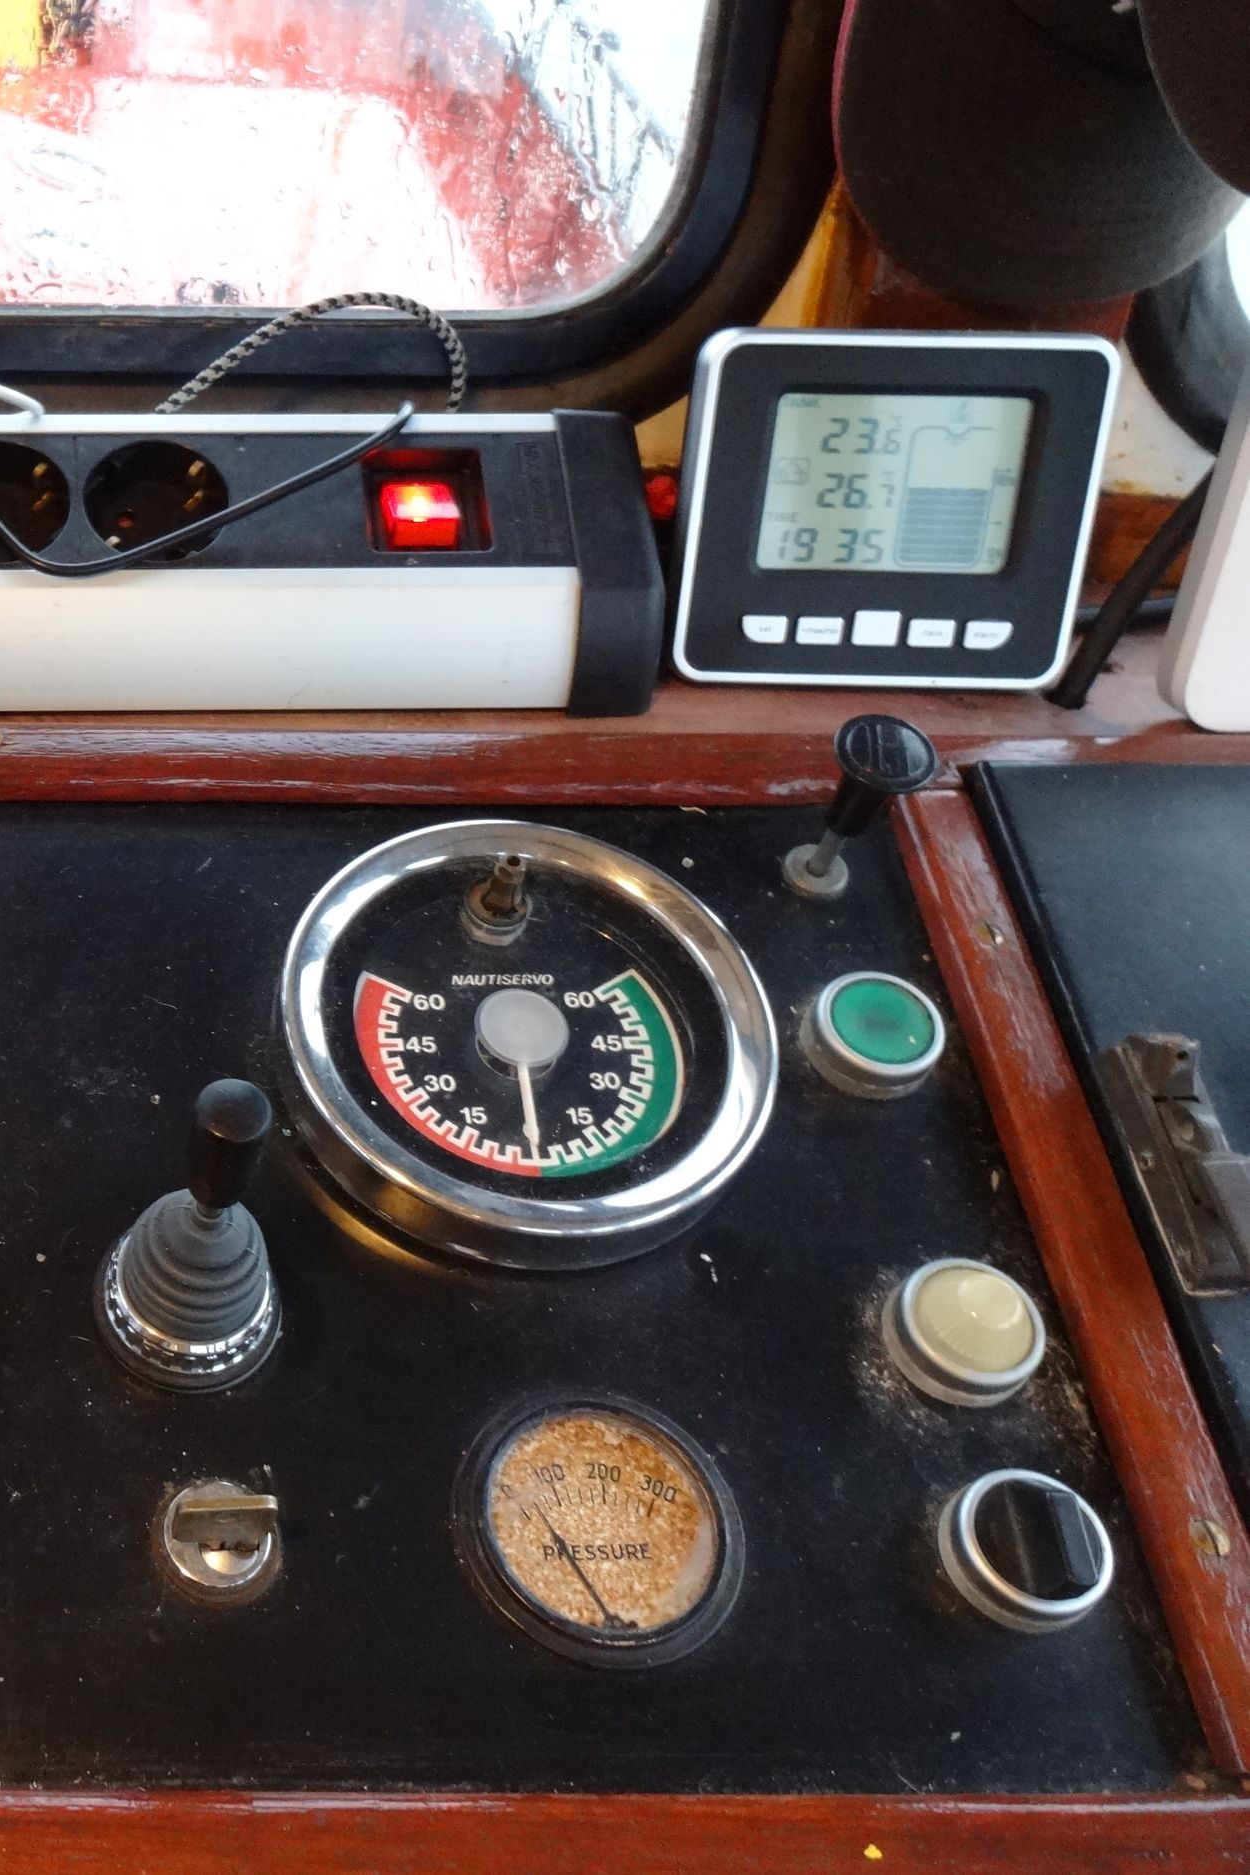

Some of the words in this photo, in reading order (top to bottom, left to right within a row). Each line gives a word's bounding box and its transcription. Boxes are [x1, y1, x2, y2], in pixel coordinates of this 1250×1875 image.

[451, 973, 554, 987] NAUTISERVO
[413, 993, 446, 1011] 60
[563, 991, 596, 1009] 60
[405, 1036, 438, 1054] 45
[591, 1034, 623, 1052] 45
[423, 1074, 457, 1093] 30
[589, 1072, 621, 1091] 30
[460, 1106, 488, 1125] 15
[565, 1106, 593, 1125] 15
[586, 1463, 622, 1483] 200
[640, 1474, 678, 1504] 300
[543, 1543, 653, 1562] PRESSURE
